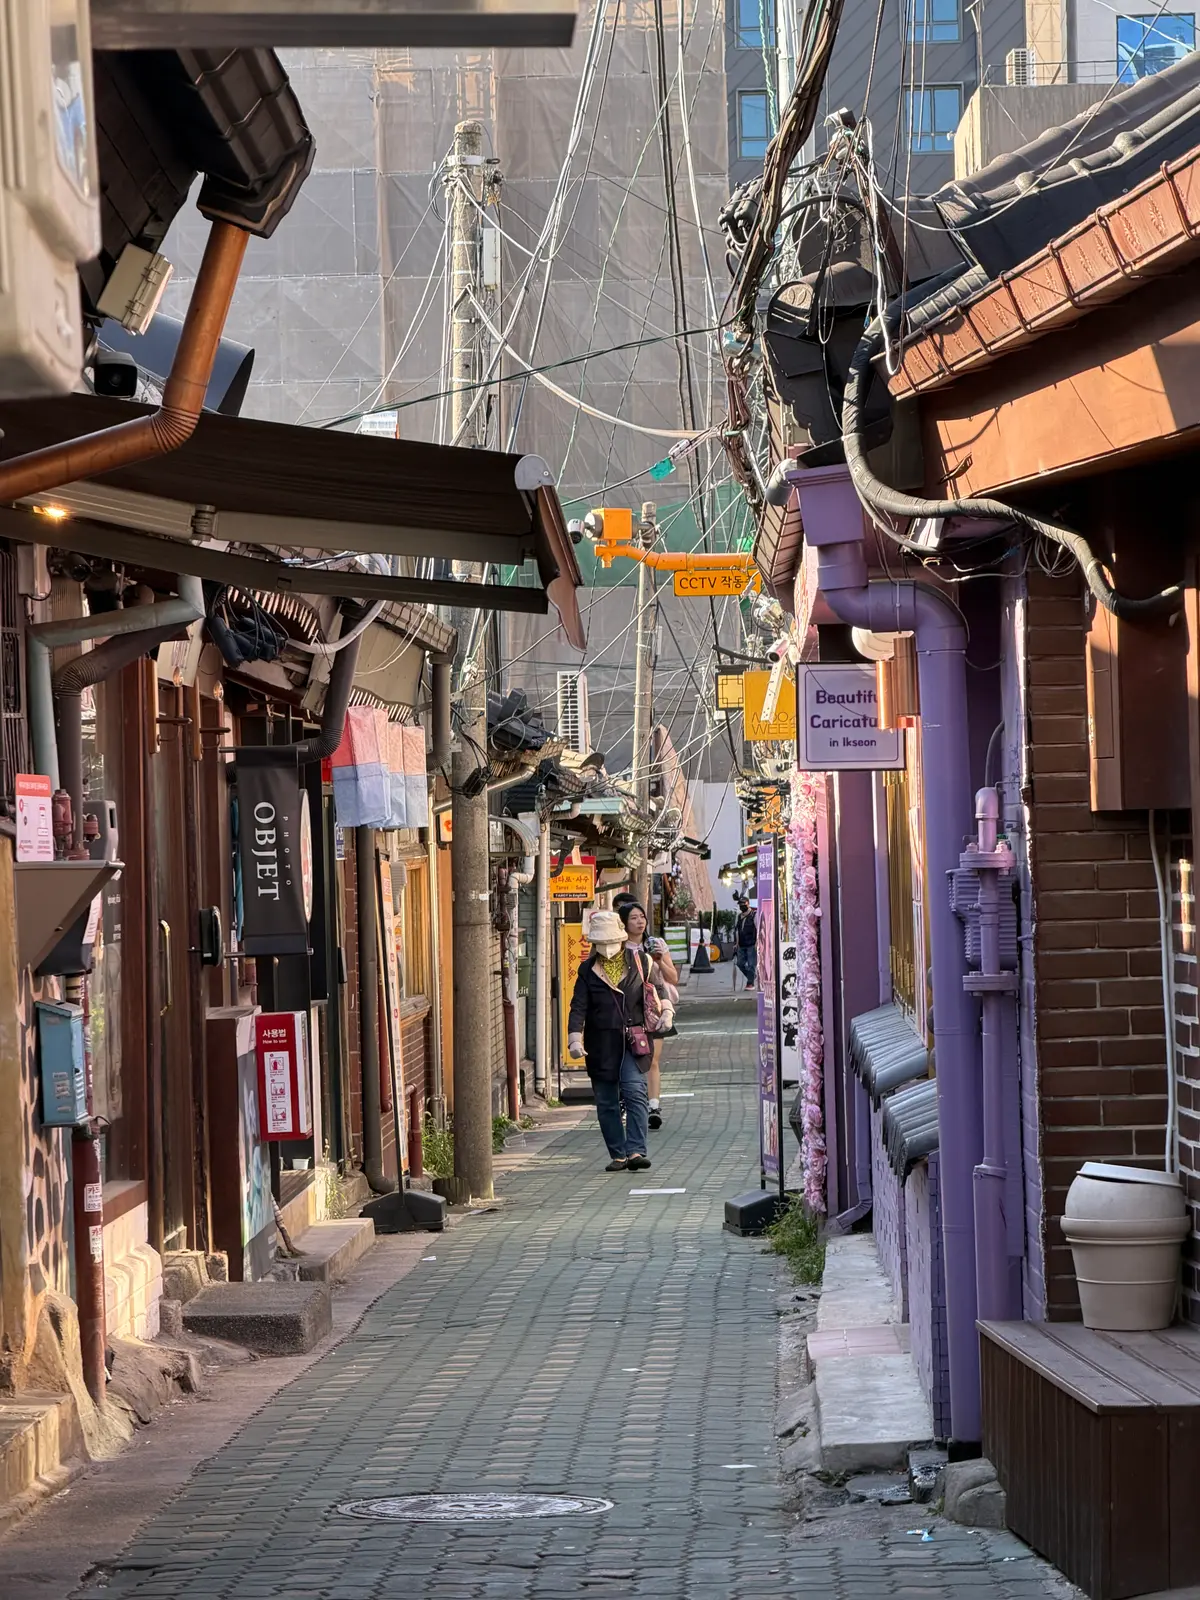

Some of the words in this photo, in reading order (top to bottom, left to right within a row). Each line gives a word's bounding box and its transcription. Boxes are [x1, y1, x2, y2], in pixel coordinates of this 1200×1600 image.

[680, 577, 717, 589] CCTV
[829, 738, 839, 747] in
[843, 737, 877, 747] Ikseon
[252, 801, 280, 901] OBJET
[283, 816, 291, 886] PHOTO
[263, 1029, 286, 1038] 사용법
